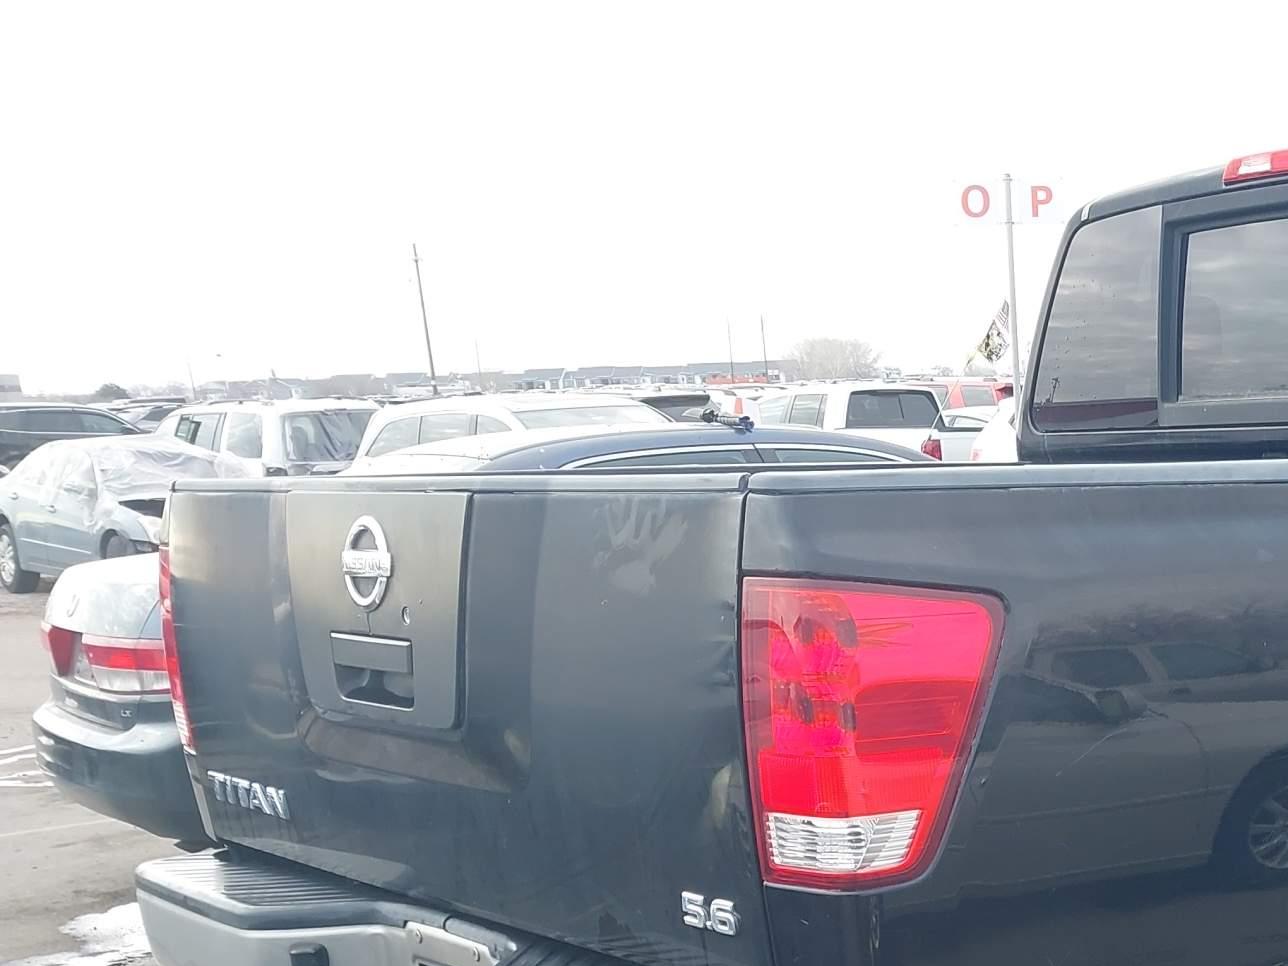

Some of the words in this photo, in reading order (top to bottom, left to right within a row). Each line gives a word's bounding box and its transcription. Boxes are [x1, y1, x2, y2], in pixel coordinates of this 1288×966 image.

[961, 184, 991, 218] O
[1030, 185, 1053, 218] P
[207, 770, 290, 820] TITAN
[681, 890, 740, 936] 5.6
